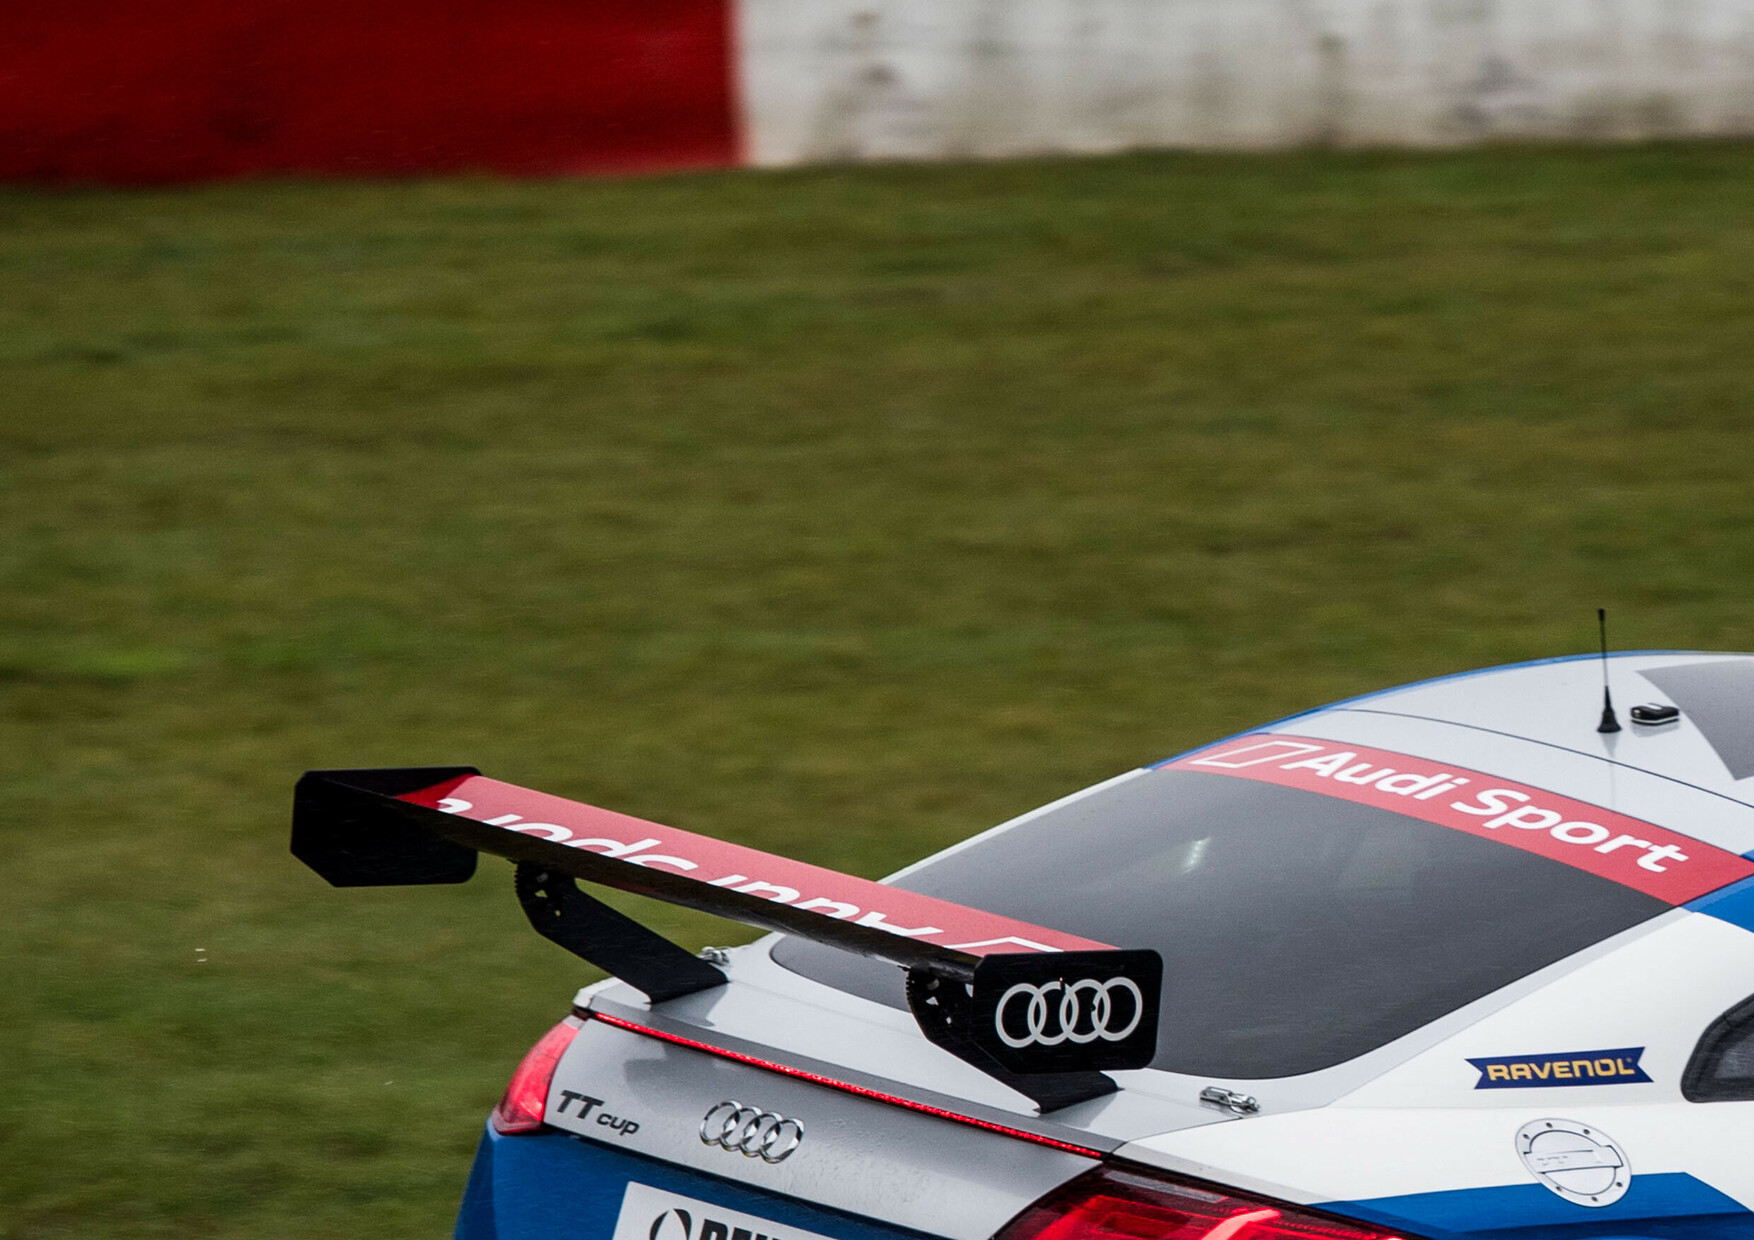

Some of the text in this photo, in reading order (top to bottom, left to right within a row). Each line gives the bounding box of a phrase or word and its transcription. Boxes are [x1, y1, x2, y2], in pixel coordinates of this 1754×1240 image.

[1281, 751, 1689, 873] Audi Sport
[1486, 1058, 1636, 1082] RAVENOL
[556, 1089, 605, 1119] TT
